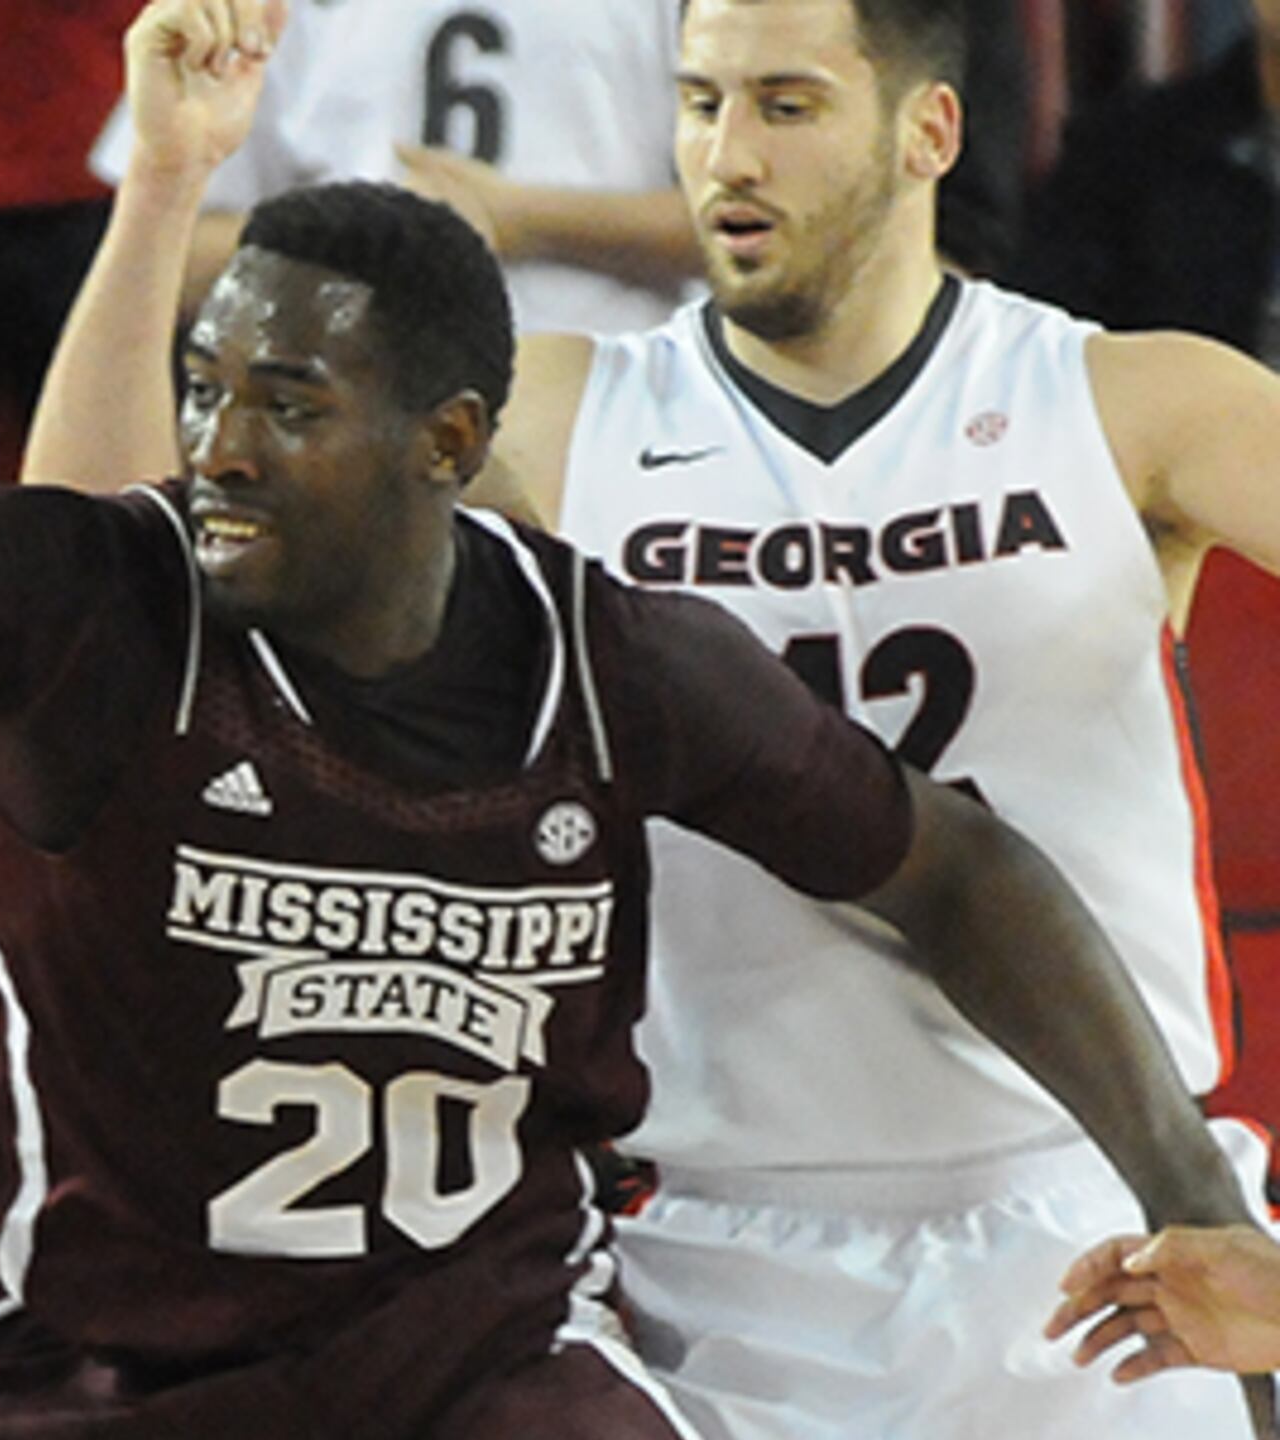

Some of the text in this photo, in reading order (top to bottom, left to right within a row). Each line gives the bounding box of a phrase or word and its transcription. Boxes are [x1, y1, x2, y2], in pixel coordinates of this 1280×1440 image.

[423, 12, 508, 165] 6
[622, 490, 1069, 592] GEORGIA
[167, 863, 613, 969] MISSISSIPPI
[290, 973, 498, 1047] STATE
[208, 1058, 532, 1258] 20
